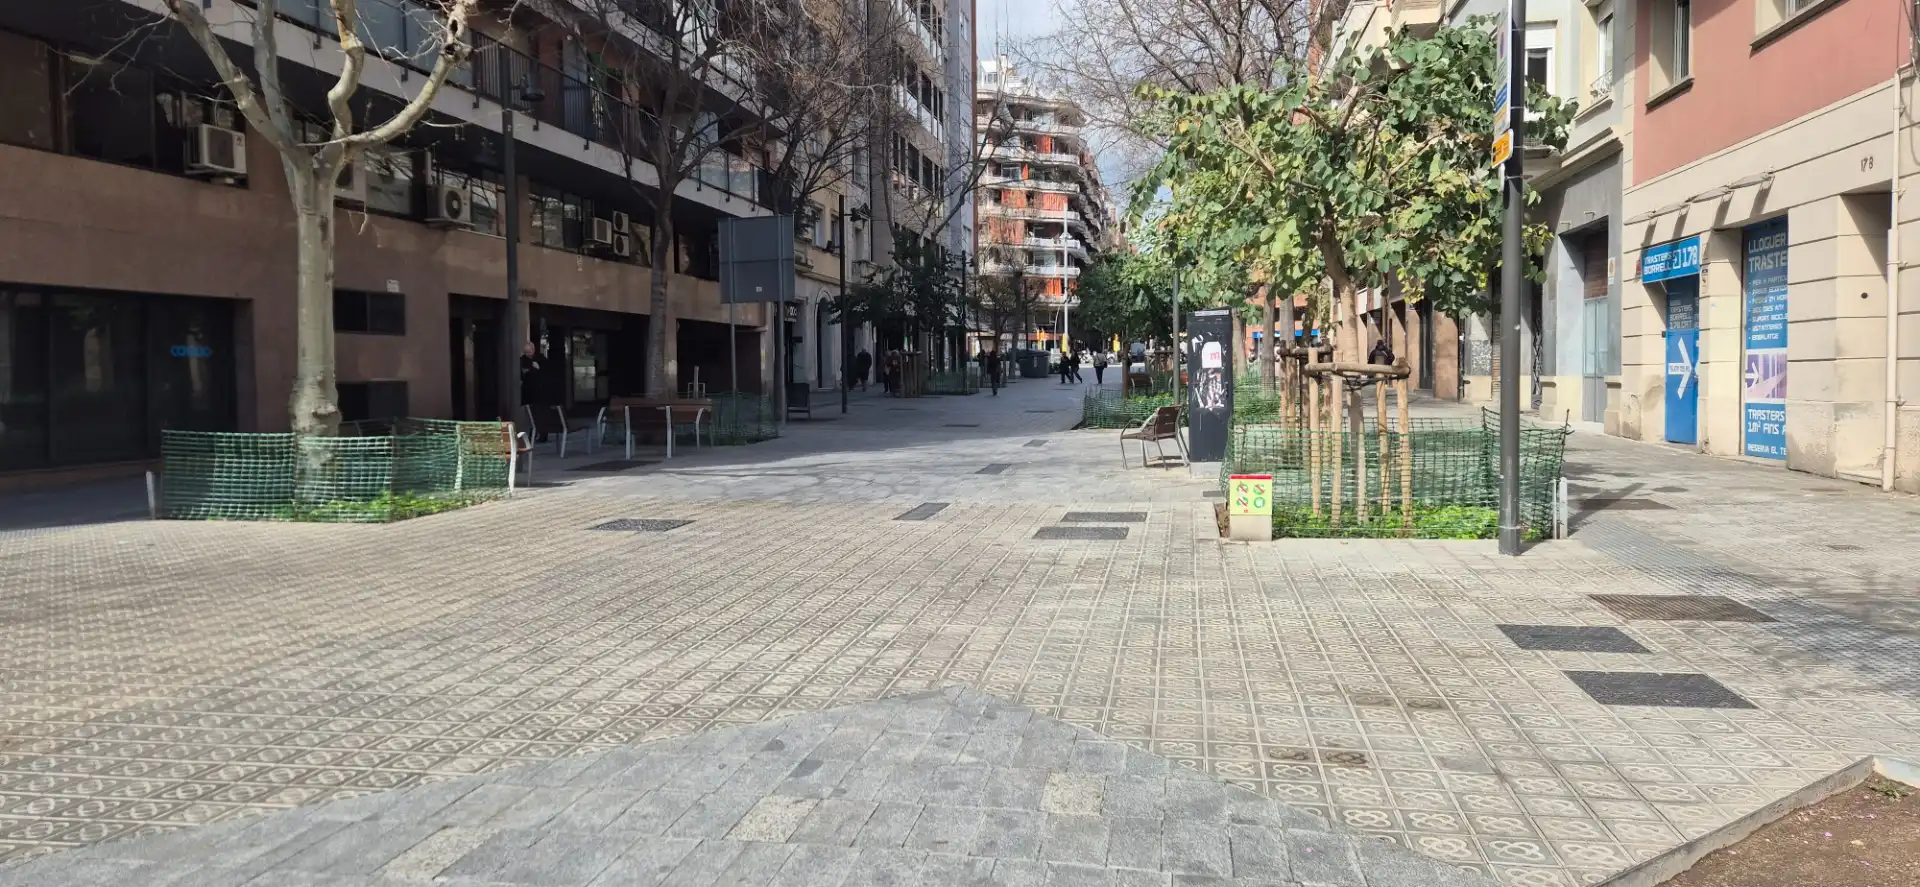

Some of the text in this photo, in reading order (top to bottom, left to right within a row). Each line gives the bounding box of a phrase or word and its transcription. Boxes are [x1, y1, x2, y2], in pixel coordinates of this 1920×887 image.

[1861, 156, 1874, 172] 178
[1749, 232, 1786, 253] LLOGUER
[1644, 252, 1672, 265] TRASTERS
[1682, 245, 1698, 267] 178
[1644, 260, 1671, 275] BORRELL
[1748, 409, 1785, 422] TRASTERS
[1763, 422, 1780, 435] FINS
[1748, 443, 1770, 454] RESERVA
